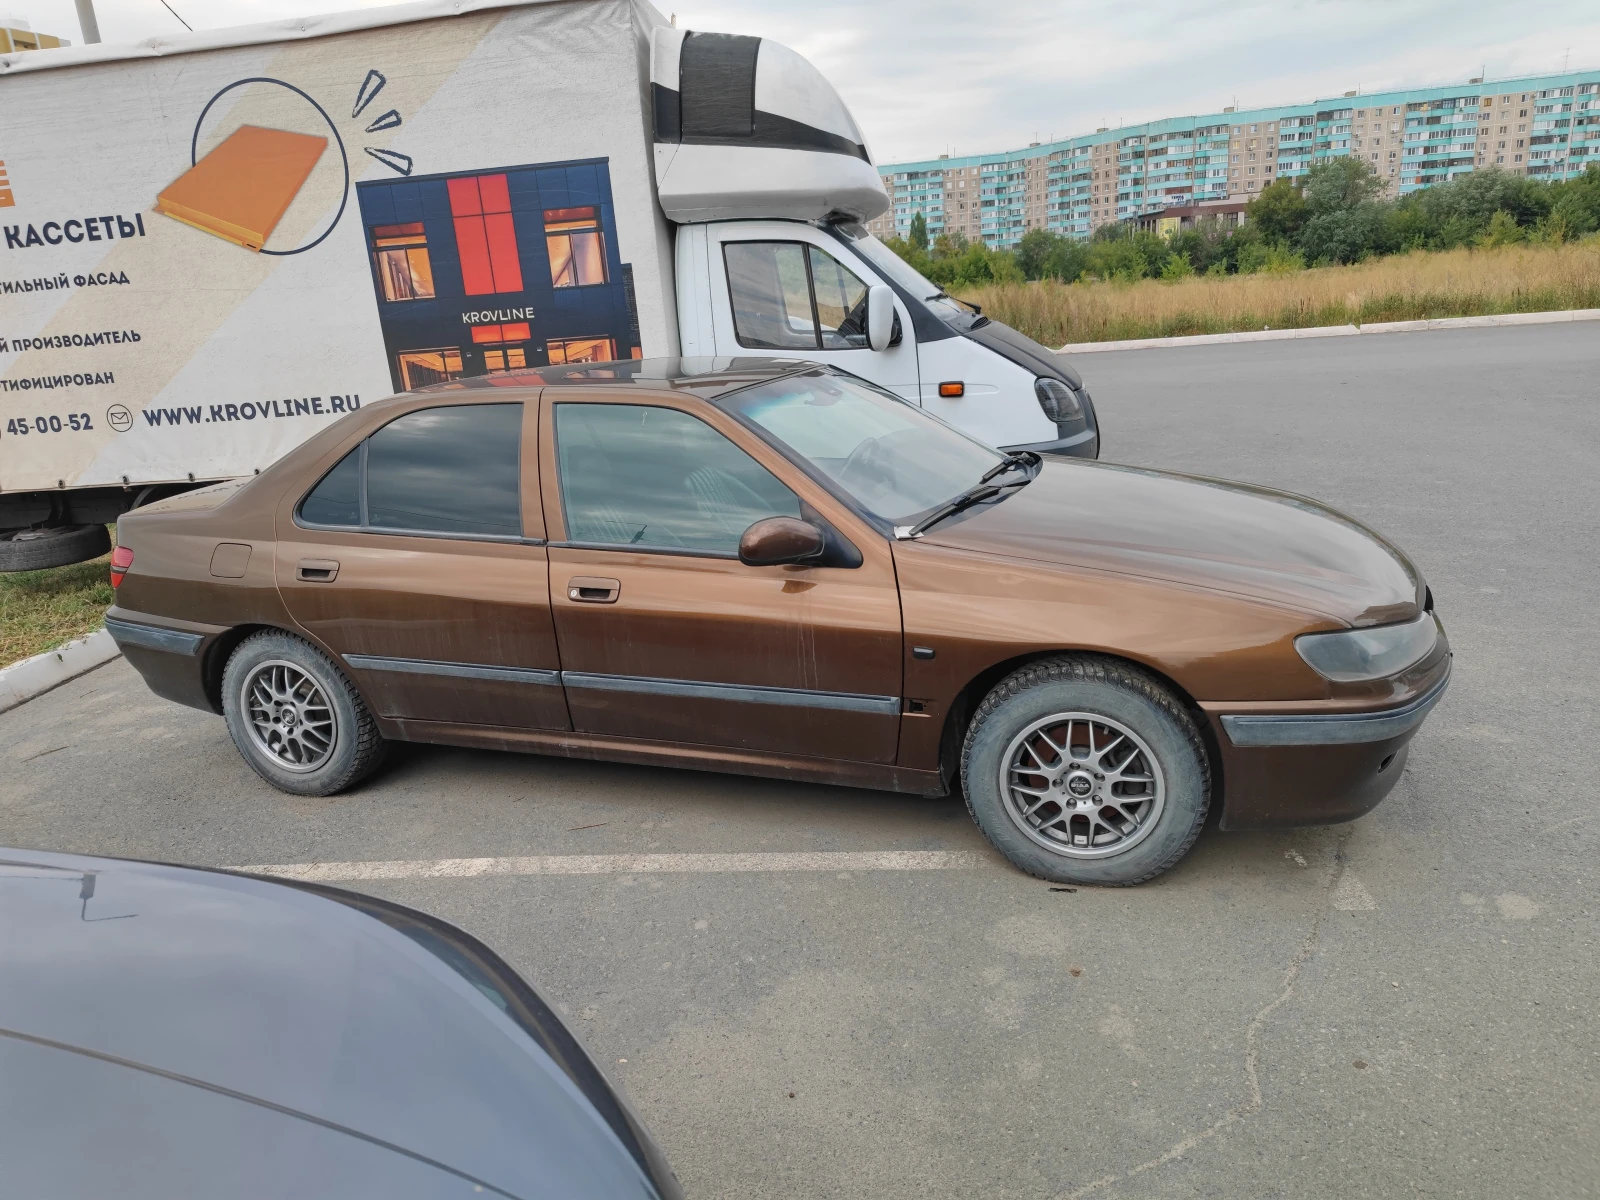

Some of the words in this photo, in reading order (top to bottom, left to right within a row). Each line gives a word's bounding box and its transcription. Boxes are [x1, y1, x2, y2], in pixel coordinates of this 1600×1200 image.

[3, 212, 146, 249] КАССЕТЫ
[73, 271, 131, 287] ФАСАД
[462, 307, 535, 324] KROVLINE
[12, 329, 142, 352] ПРОИЗВОДИТЕЛЬ
[0, 371, 115, 392] ТИФИЦИРОВАН
[7, 412, 94, 435] 45-00-52
[142, 394, 361, 427] WWW.KROVLINE.RU
